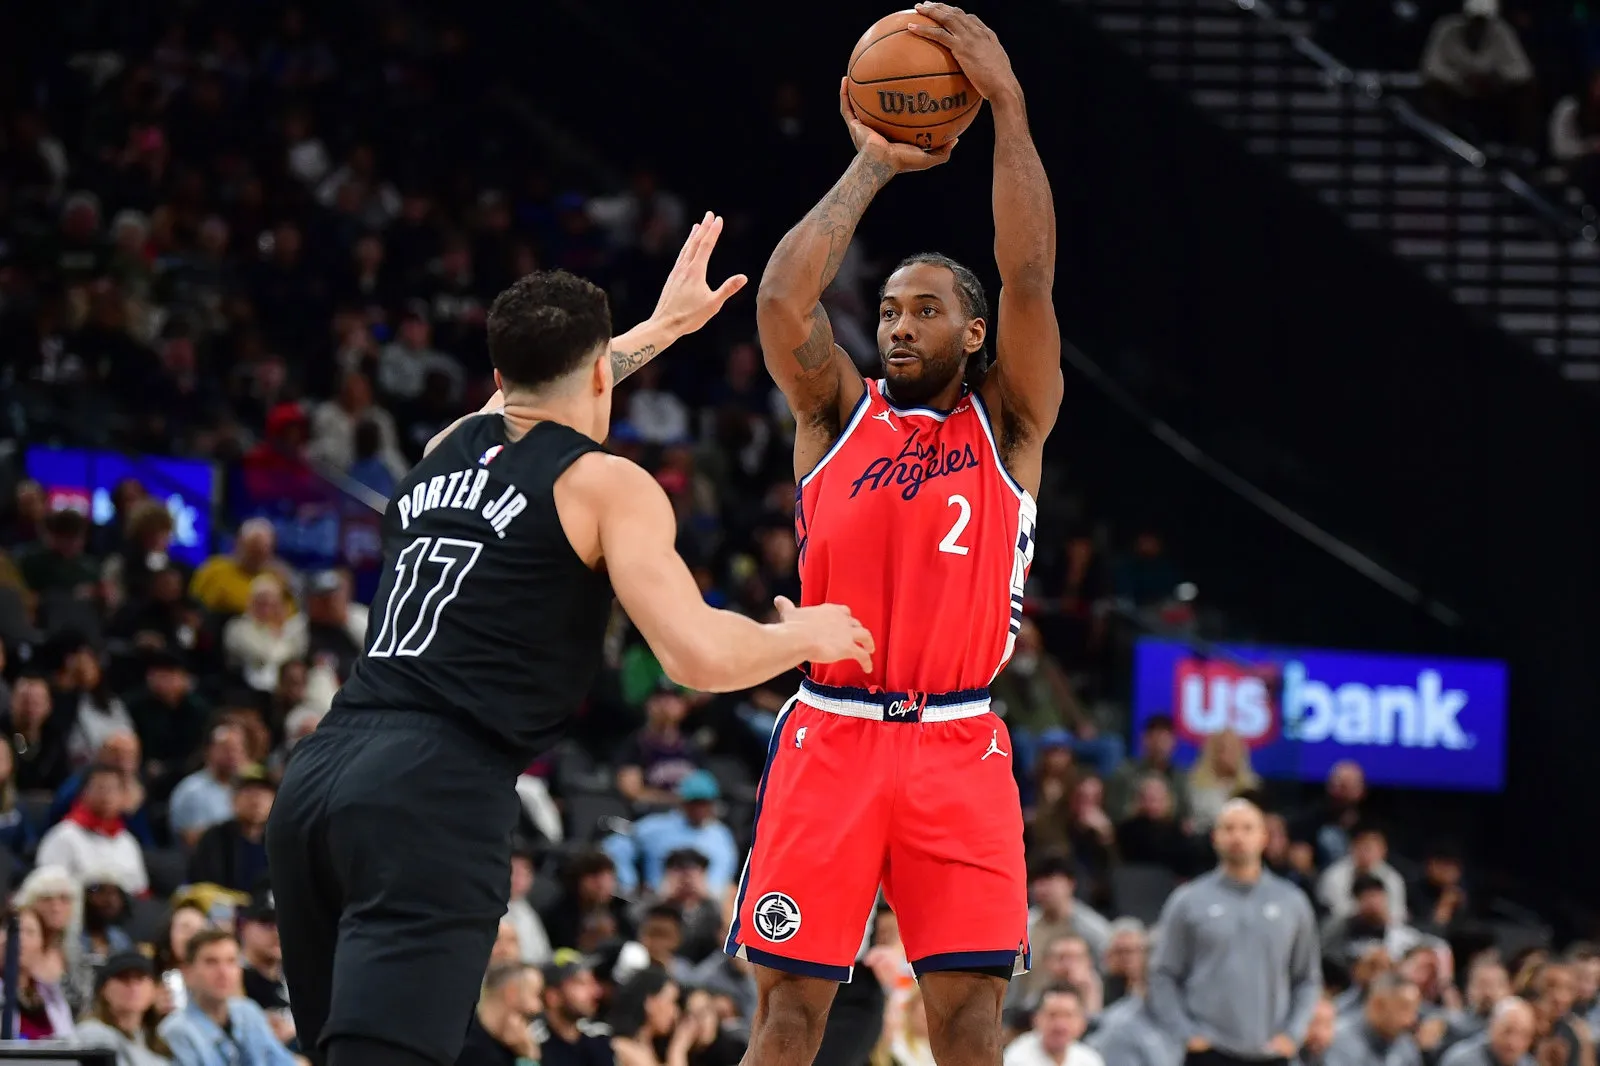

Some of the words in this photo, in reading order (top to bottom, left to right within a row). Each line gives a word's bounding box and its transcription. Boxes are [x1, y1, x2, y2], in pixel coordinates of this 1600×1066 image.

[877, 89, 968, 114] Wilson
[848, 442, 979, 501] Angeles
[896, 428, 938, 462] Los
[397, 468, 490, 530] PORTER
[481, 484, 528, 539] JR.
[938, 494, 972, 556] 2
[367, 537, 484, 657] 17
[1180, 672, 1274, 739] us
[1283, 659, 1468, 749] bank
